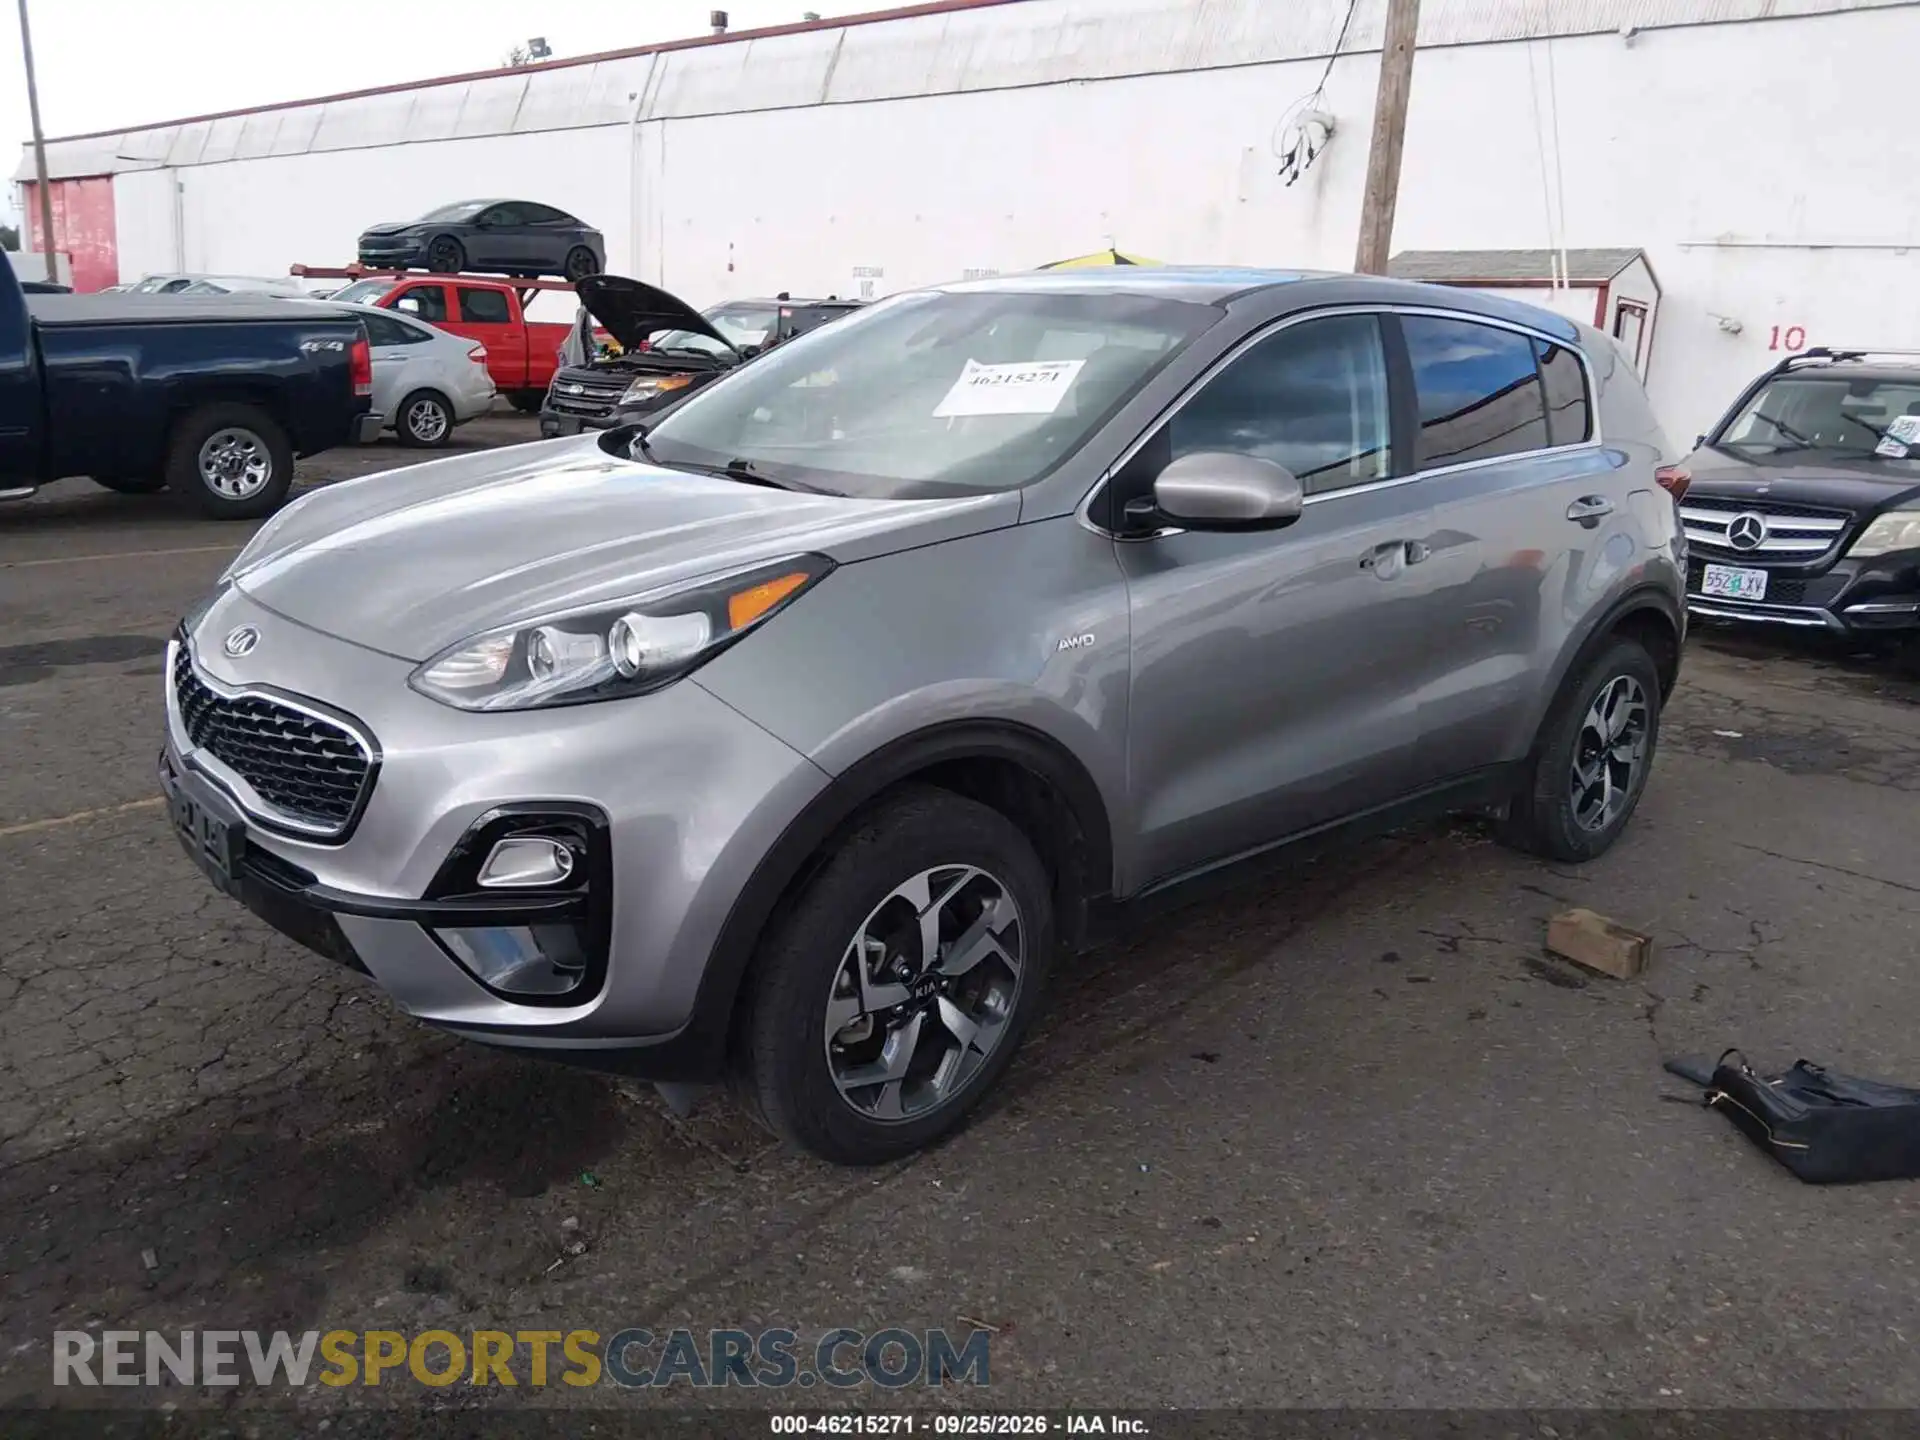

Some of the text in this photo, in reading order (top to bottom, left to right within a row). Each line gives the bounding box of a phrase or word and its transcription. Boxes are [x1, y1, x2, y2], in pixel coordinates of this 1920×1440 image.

[1768, 325, 1805, 351] 10
[1056, 634, 1095, 651] AWD
[915, 982, 936, 998] KIA
